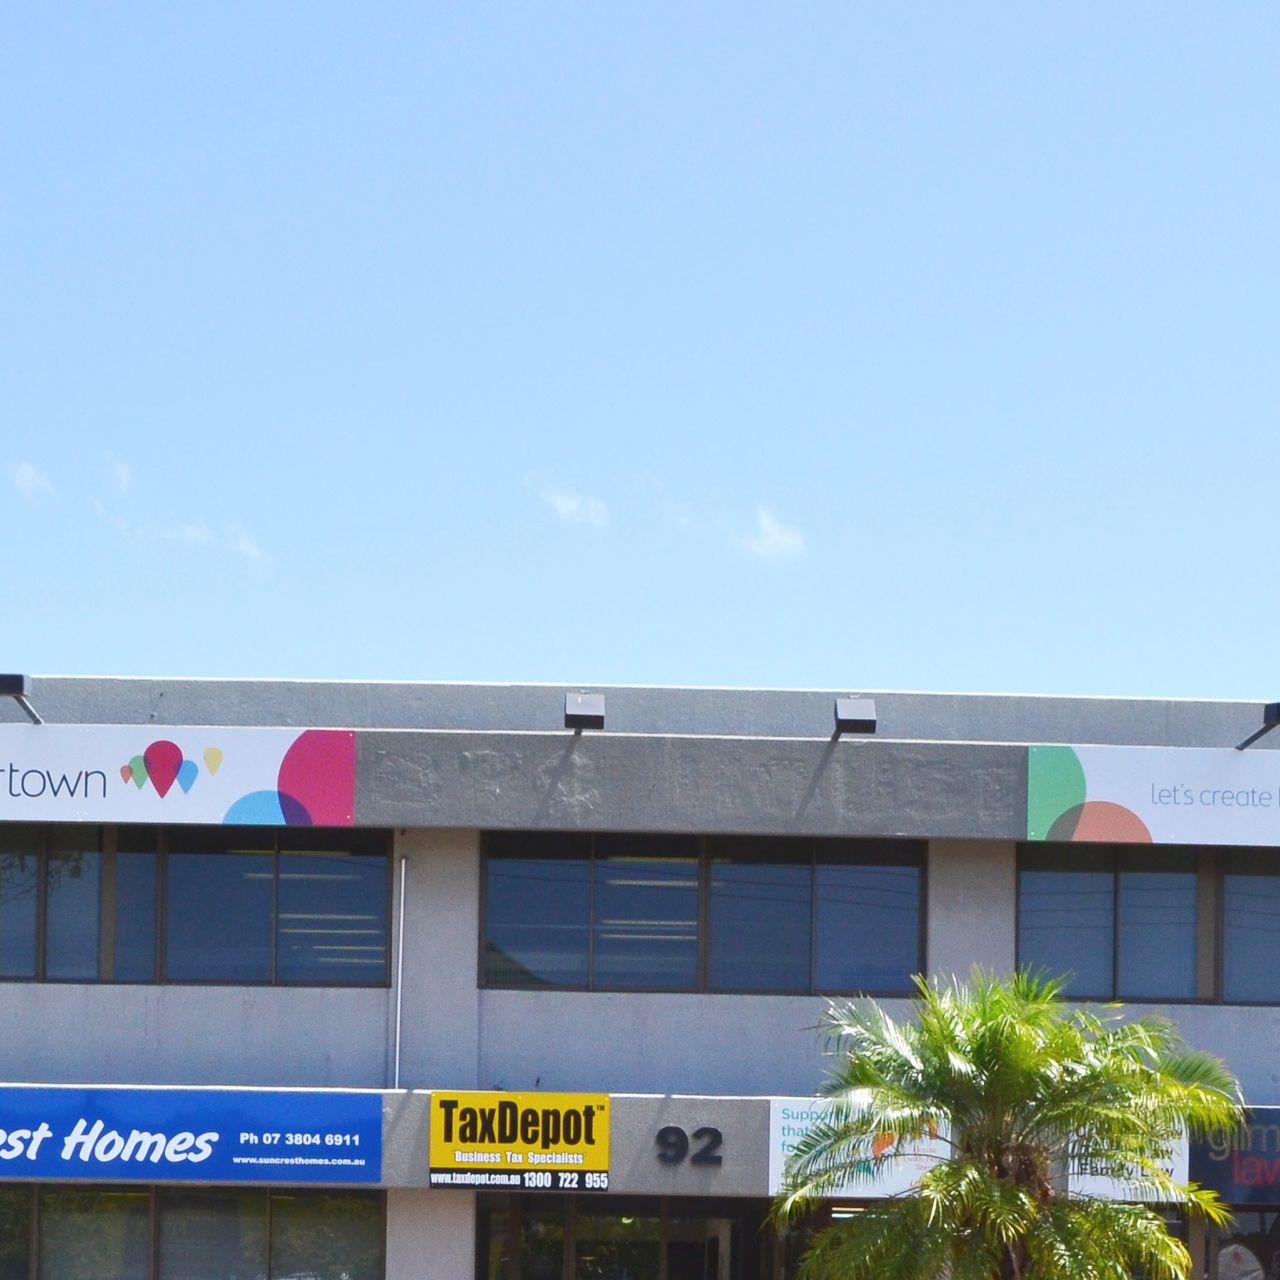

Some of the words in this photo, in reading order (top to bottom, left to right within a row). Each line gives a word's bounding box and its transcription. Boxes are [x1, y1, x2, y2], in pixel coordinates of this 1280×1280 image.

[1199, 786, 1272, 807] create
[439, 1100, 595, 1149] TaxDepot
[60, 1118, 219, 1163] Homes
[239, 1132, 258, 1144] Ph
[262, 1133, 280, 1145] 07
[285, 1133, 321, 1145] 3804
[325, 1134, 360, 1146] 6911
[656, 1125, 722, 1166] 92
[232, 1156, 365, 1166] www.suncresthomes.com.au
[455, 1151, 501, 1163] Business
[506, 1151, 523, 1163] Tax
[528, 1152, 584, 1164] Specialists
[523, 1172, 551, 1187] 1300
[558, 1172, 578, 1188] 722
[585, 1172, 608, 1188] 955
